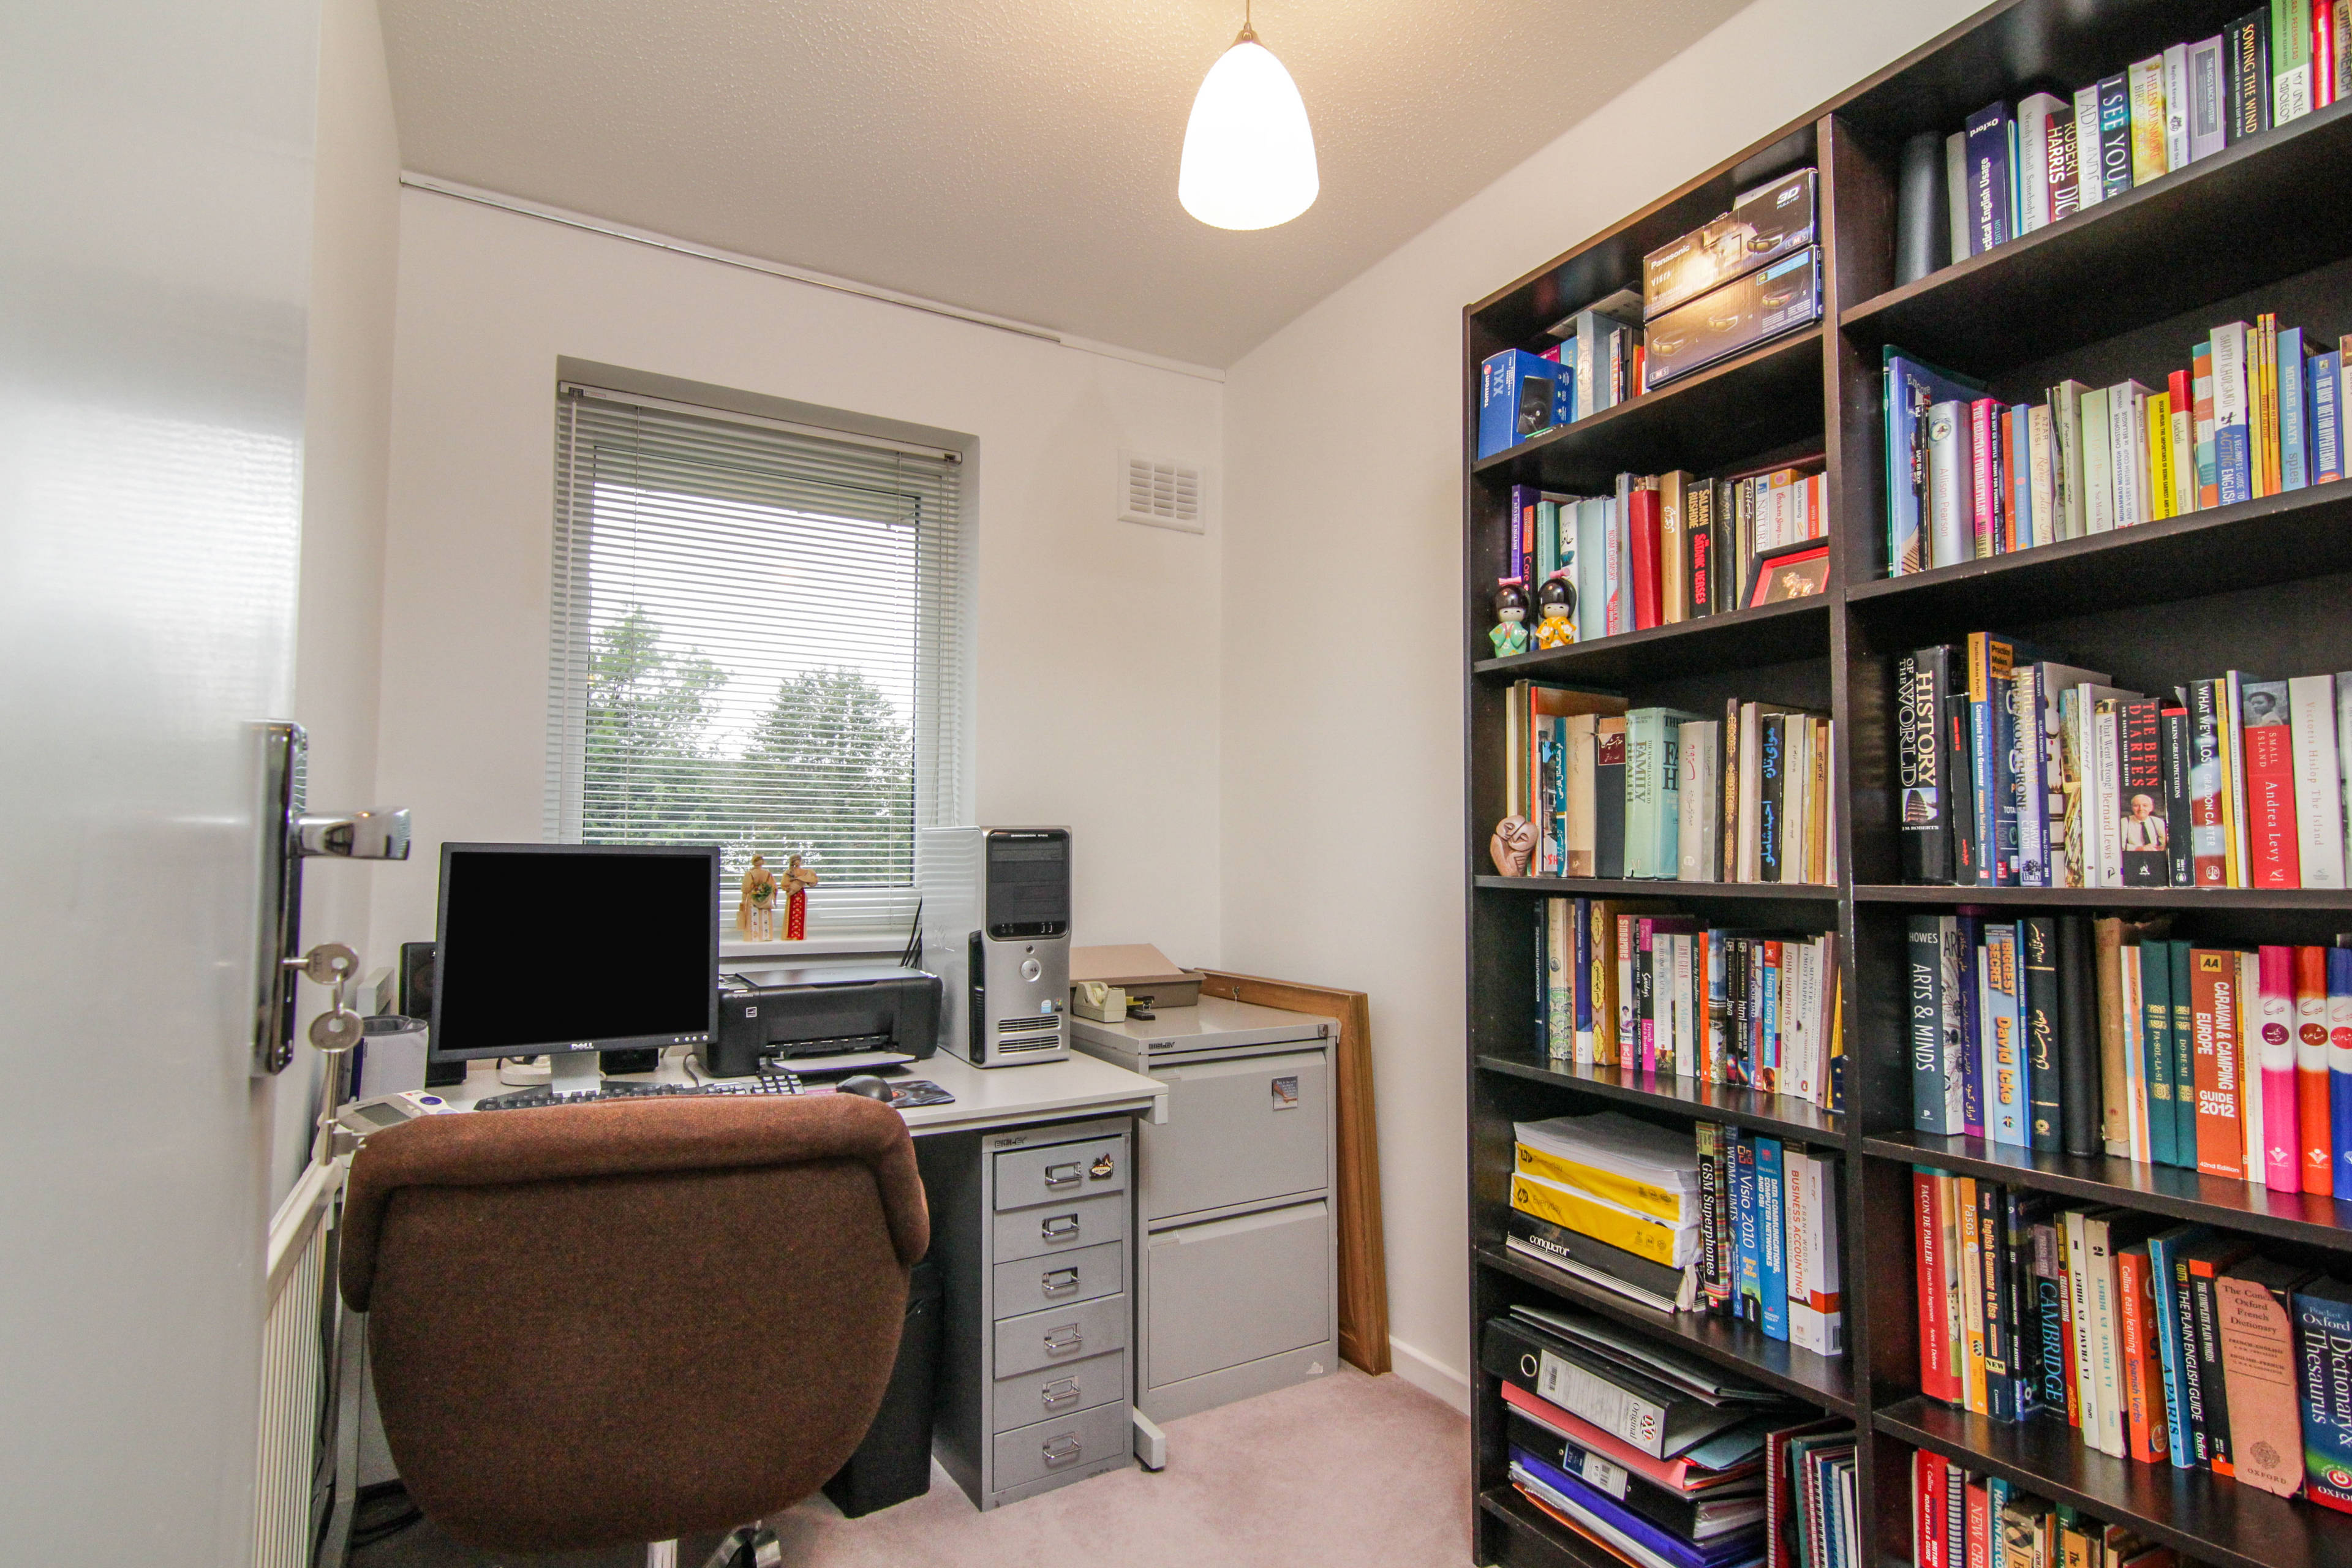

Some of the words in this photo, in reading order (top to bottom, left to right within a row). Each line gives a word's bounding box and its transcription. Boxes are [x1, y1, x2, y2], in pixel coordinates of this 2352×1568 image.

[2242, 23, 2255, 72] SOWING
[2146, 74, 2157, 102] HELEN
[2244, 73, 2256, 98] THE
[1970, 118, 1999, 137] Oxford
[2103, 95, 2124, 131] SEE
[2245, 101, 2257, 133] WIND
[2149, 103, 2161, 158] DUNMORE
[2048, 127, 2065, 184] HARRIS
[2105, 133, 2127, 182] YOU
[1980, 157, 1992, 188] Usage
[1777, 185, 1801, 205] 3D
[1980, 185, 1992, 223] English
[1651, 245, 1691, 270] Panasonic
[1651, 270, 1672, 287] VIERA
[2220, 334, 2231, 362] SHAPPI
[1906, 373, 1931, 395] Encore
[2221, 363, 2234, 409] KHORSANDI
[2285, 365, 2296, 411] MICHAEL
[2286, 411, 2297, 445] FRAYN
[2221, 431, 2232, 467] ACTING
[2288, 453, 2303, 484] spies
[1939, 468, 1950, 503] Allison
[2222, 468, 2235, 505] ENGLISH
[1689, 492, 1698, 529] RUSHDIE
[1698, 489, 1709, 526] SALMAN
[1940, 505, 1950, 538] Pearson
[1561, 529, 1574, 546] حافظ
[1757, 499, 1766, 549] NATURE
[1694, 533, 1707, 569] SATANIC
[1523, 556, 1532, 581] Core
[1695, 570, 1706, 605] VERSES
[1905, 657, 1914, 671] OF
[2198, 685, 2209, 717] WHAT
[1899, 682, 1917, 787] WORLD
[1915, 669, 1936, 787] HISTORY
[2103, 717, 2113, 736] What
[2143, 703, 2155, 736] THE
[2199, 717, 2211, 745] WE'VE
[2306, 701, 2315, 744] Victoria
[1764, 727, 1778, 758] هوای
[2104, 736, 2113, 759] Went
[2129, 705, 2144, 787] DIARIES
[2201, 745, 2212, 767] LOST
[2258, 731, 2266, 767] ISLAND
[2269, 732, 2278, 764] SMALL
[1635, 741, 1647, 803] FAMILY
[1763, 758, 1776, 778] تازه
[2105, 760, 2114, 790] Wrong?
[2144, 741, 2158, 787] BENN
[2308, 750, 2317, 783] Hislop
[2204, 774, 2214, 815] GRAYDON
[2266, 781, 2280, 827] Andrea
[2312, 790, 2321, 809] The
[1761, 801, 1774, 827] احمد
[2103, 792, 2113, 831] Bernard
[2205, 815, 2215, 846] CARTER
[2313, 814, 2324, 846] Island
[1761, 827, 1776, 867] شاملو
[2104, 833, 2114, 860] Lewis
[2267, 833, 2281, 862] Levy
[1619, 919, 1629, 959] SINGAPORE
[1678, 944, 1688, 961] JANE
[1909, 932, 1938, 943] HOWES
[1678, 961, 1688, 979] GREEN
[1913, 963, 1932, 1000] ARTS
[1989, 943, 2002, 990] SECRET
[2002, 943, 2015, 996] BIGGEST
[1642, 972, 1651, 997] Sawday's
[1738, 1000, 1747, 1023] html
[1914, 1005, 1934, 1019] &
[2213, 981, 2231, 1030] CARAVAN
[1148, 1041, 1175, 1050] BISLEY
[1915, 1025, 1935, 1072] MINDS
[1996, 1016, 2013, 1065] David
[2196, 1012, 2213, 1055] EUROPE
[2303, 1027, 2324, 1039] مشاعره
[2216, 1041, 2234, 1091] CAMPING
[1999, 1069, 2016, 1105] Icke
[2200, 1090, 2234, 1104] GUIDE
[2199, 1102, 2235, 1118] 2012
[994, 1136, 1027, 1148] BISLEY
[1702, 1163, 1714, 1193] GSM
[2217, 1163, 2239, 1173] Edition
[1517, 1188, 1528, 1203] hp
[1532, 1195, 1562, 1215] Everyday
[1740, 1175, 1753, 1209] Visio
[1763, 1177, 1772, 1222] COMPUTER
[1791, 1169, 1801, 1223] BUSINESS
[1529, 1235, 1570, 1257] conqueror
[1703, 1195, 1716, 1276] Superphones
[1741, 1214, 1755, 1249] 2010
[1771, 1197, 1781, 1275] COMMUNICATIONS,
[1981, 1218, 1994, 1245] English
[1792, 1226, 1803, 1295] ACCOUNTING
[1984, 1245, 1996, 1292] Grammar
[2176, 1264, 2188, 1282] CUTTS
[2122, 1265, 2131, 1293] Collins
[2222, 1286, 2241, 1296] The
[1987, 1292, 1996, 1302] in
[1988, 1302, 1998, 1319] Use
[2124, 1294, 2133, 1316] easy
[2177, 1290, 2190, 1313] THE
[2234, 1297, 2268, 1310] Oxford
[2180, 1313, 2193, 1343] PLAIN
[2230, 1316, 2277, 1335] Dictionary
[2237, 1308, 2269, 1322] French
[2302, 1313, 2351, 1332] Oxford
[2039, 1282, 2064, 1403] CAMBRIDGE
[2126, 1316, 2136, 1354] learning
[1986, 1359, 2005, 1371] NEW
[2130, 1358, 2140, 1394] Spanish
[2184, 1343, 2198, 1386] ENGLISH
[2304, 1329, 2328, 1425] Thesaurus
[2133, 1396, 2141, 1424] Verbs
[2188, 1387, 2202, 1422] GUIDE
[1630, 1402, 1640, 1440] Original
[2196, 1431, 2207, 1460] Oxford
[2247, 1468, 2287, 1485] OXFORD
[1970, 1502, 1983, 1539] NEW
[2070, 1551, 2080, 1567] The
